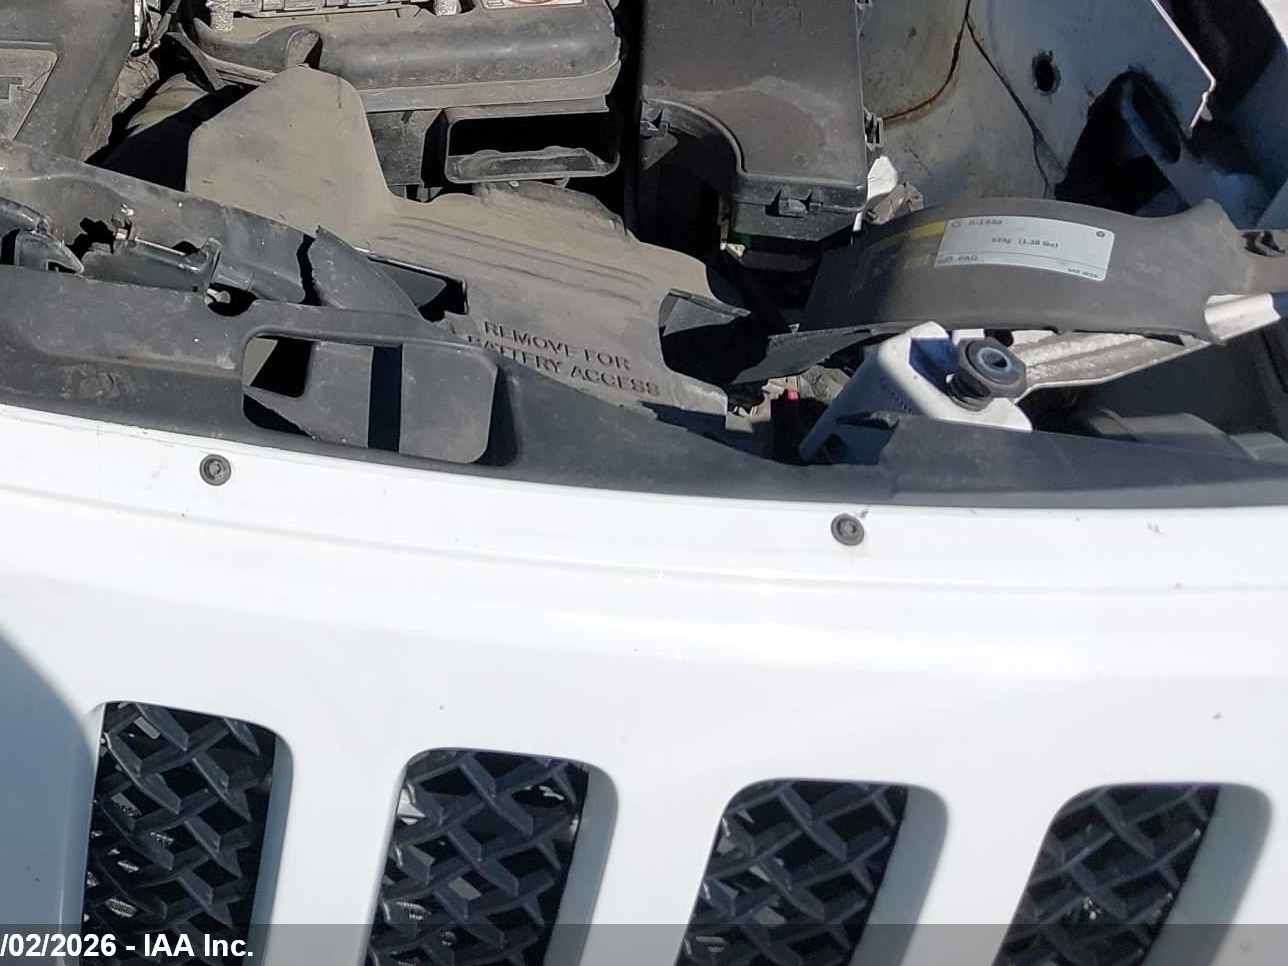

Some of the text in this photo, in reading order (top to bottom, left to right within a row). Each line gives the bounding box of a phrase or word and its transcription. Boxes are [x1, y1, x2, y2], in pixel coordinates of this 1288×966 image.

[483, 321, 632, 372] REMOVE FOR
[570, 366, 661, 397] ACCESS
